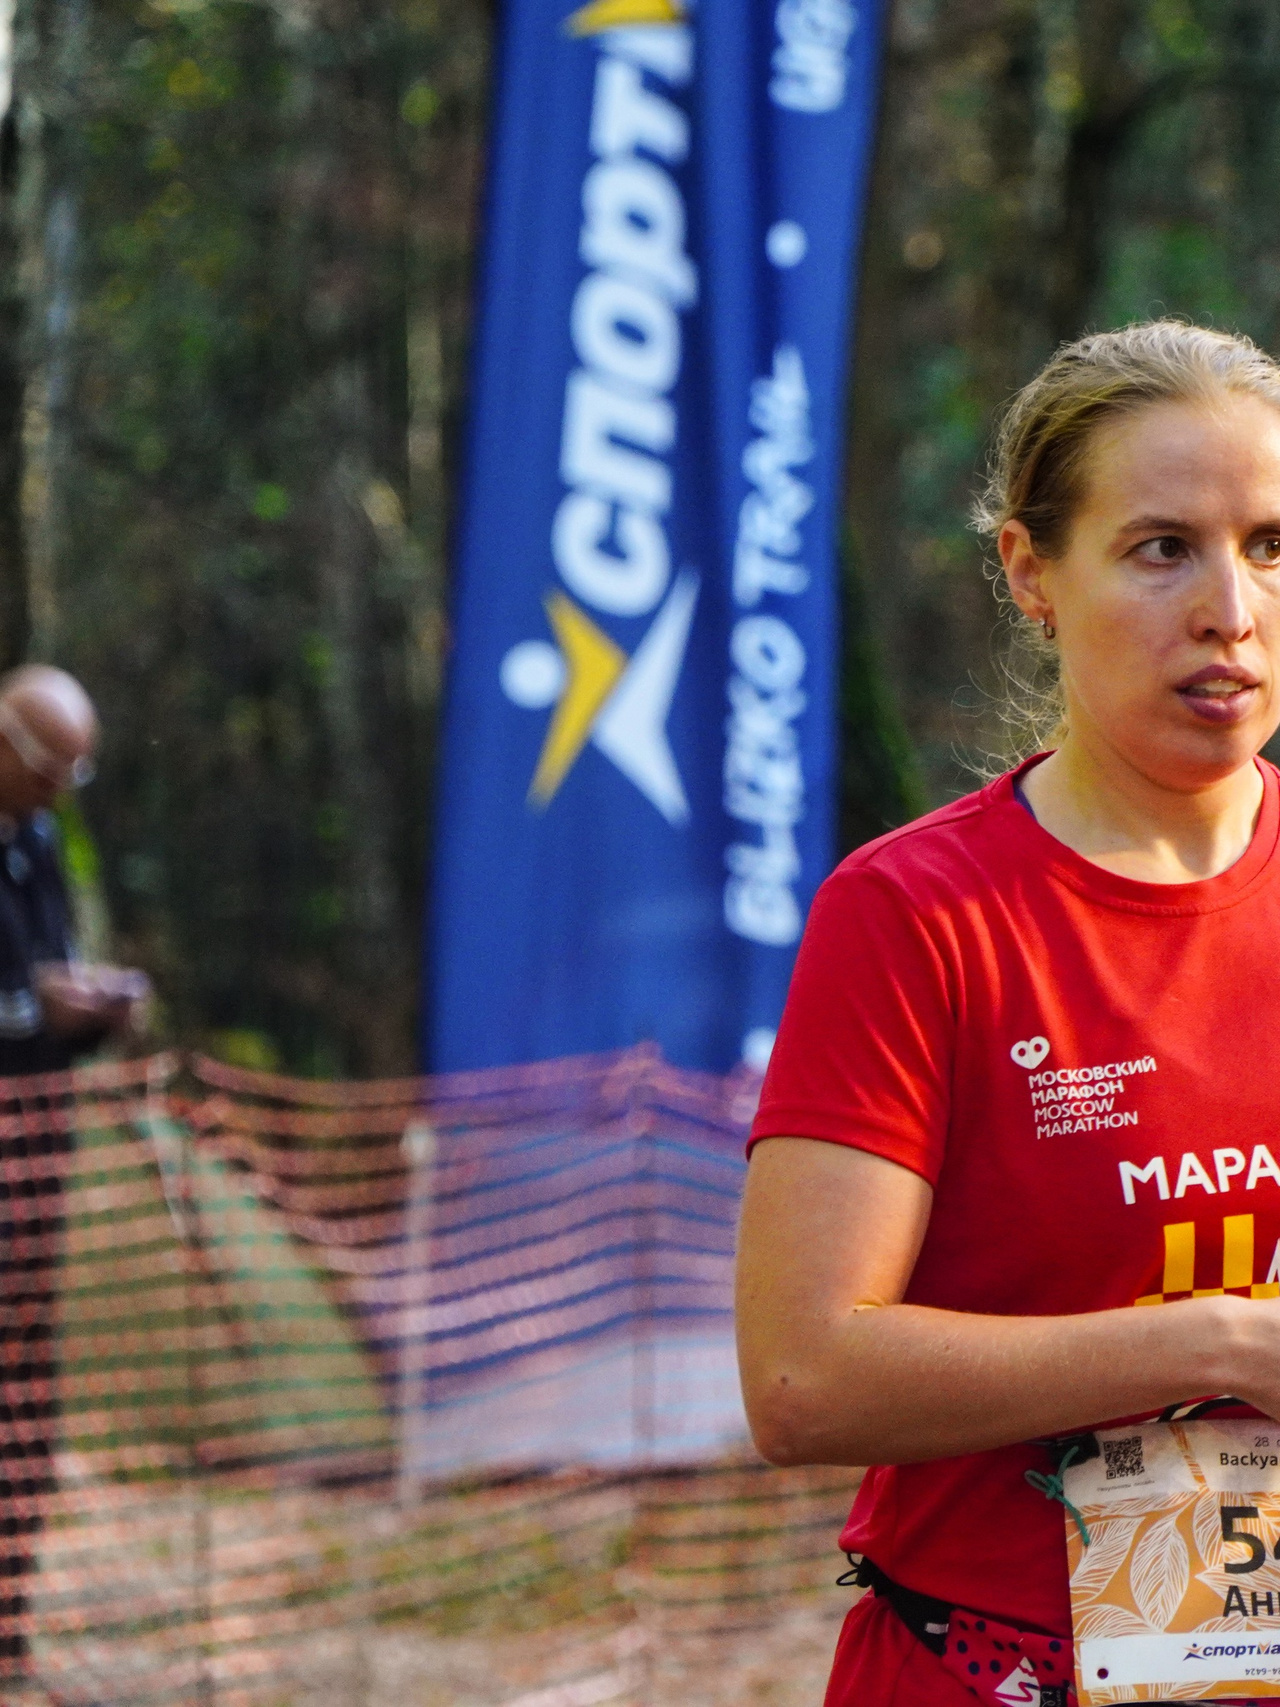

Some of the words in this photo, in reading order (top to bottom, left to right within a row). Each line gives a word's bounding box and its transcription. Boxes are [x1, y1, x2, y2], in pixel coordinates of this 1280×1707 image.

[1028, 1055, 1157, 1089] МОСКОВСКИЙ
[1031, 1079, 1124, 1106] МАРАФОН
[1034, 1097, 1115, 1123] MOSCOW
[1037, 1110, 1138, 1140] MARATHON
[1254, 1436, 1270, 1448] 28
